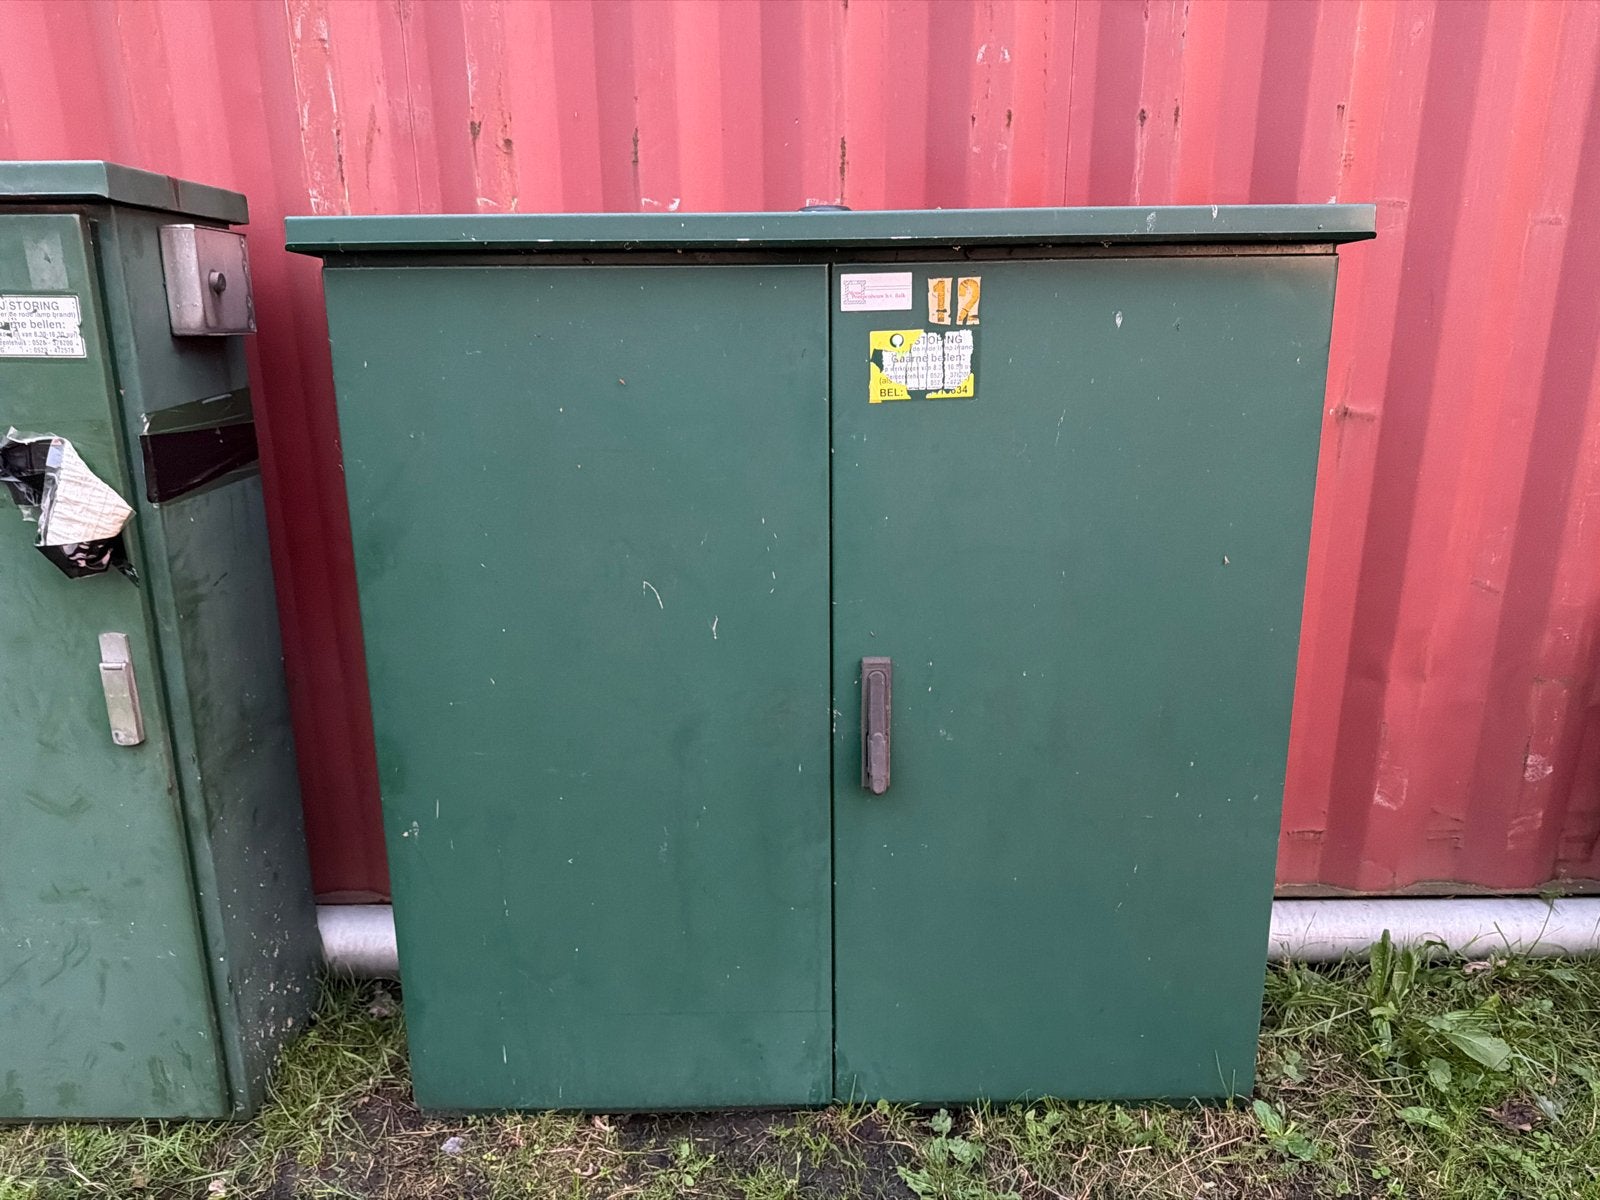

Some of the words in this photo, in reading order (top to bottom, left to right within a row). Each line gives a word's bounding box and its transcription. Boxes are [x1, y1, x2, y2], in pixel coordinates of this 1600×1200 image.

[933, 279, 980, 323] 12
[9, 301, 59, 311] STORING
[30, 320, 66, 329] bellen:
[931, 353, 966, 362] belen:
[879, 388, 904, 397] BEL:
